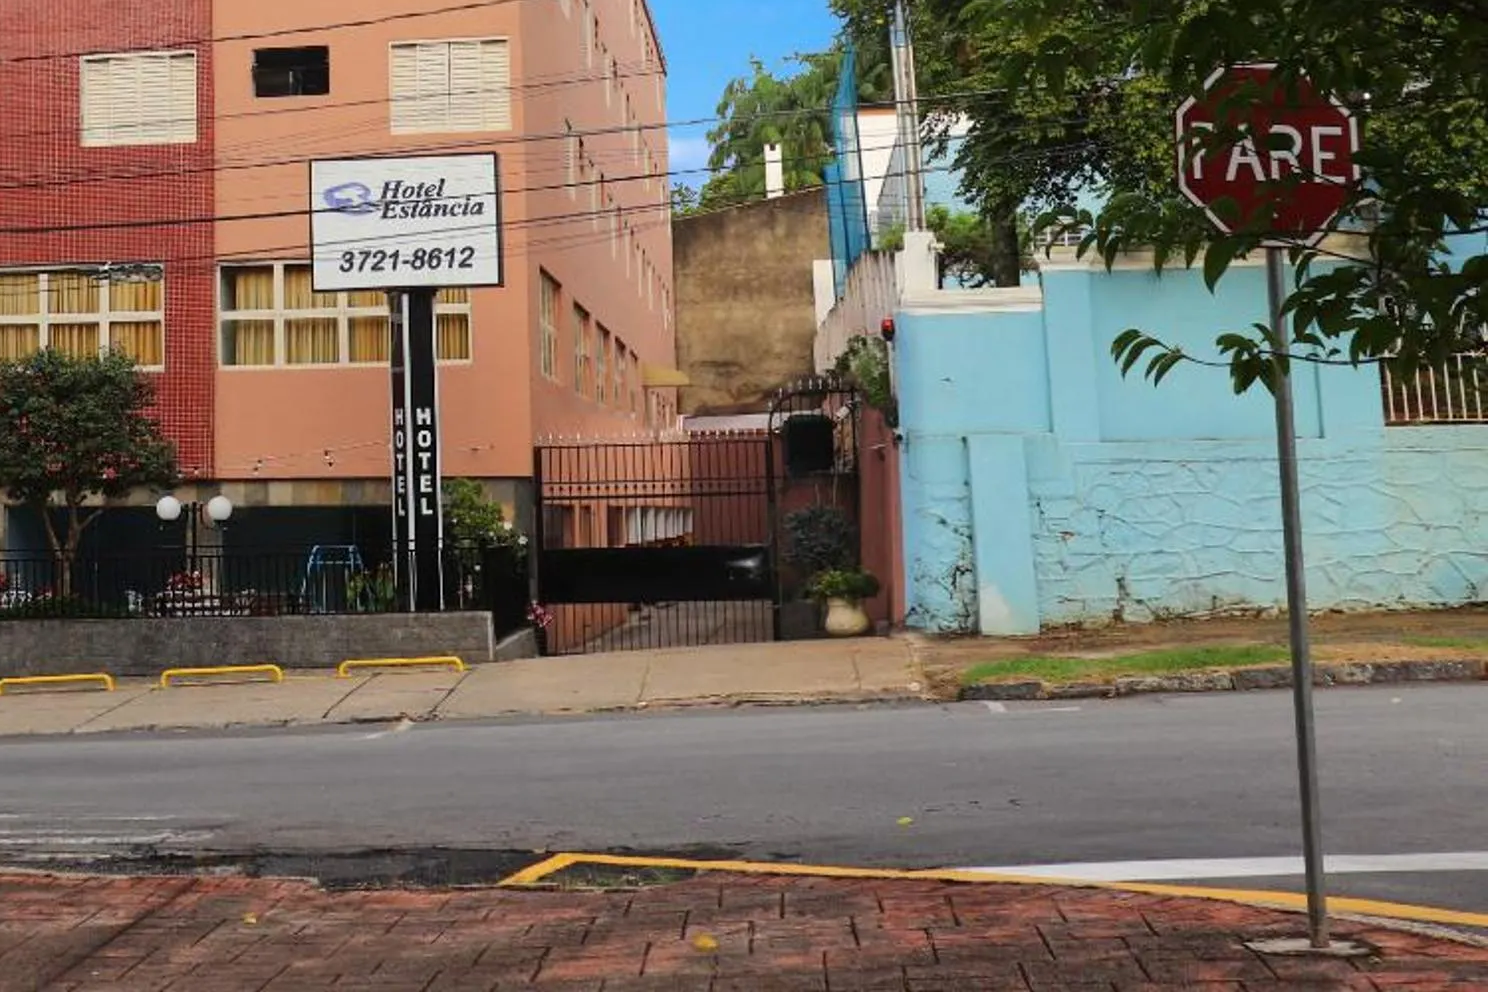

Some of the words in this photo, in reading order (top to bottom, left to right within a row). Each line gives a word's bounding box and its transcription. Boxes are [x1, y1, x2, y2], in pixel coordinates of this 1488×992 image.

[381, 178, 445, 200] Hotel
[381, 196, 484, 219] Estância
[339, 246, 475, 273] 3721-8612
[395, 408, 406, 516] HOTEL
[416, 408, 433, 515] HOTEL
